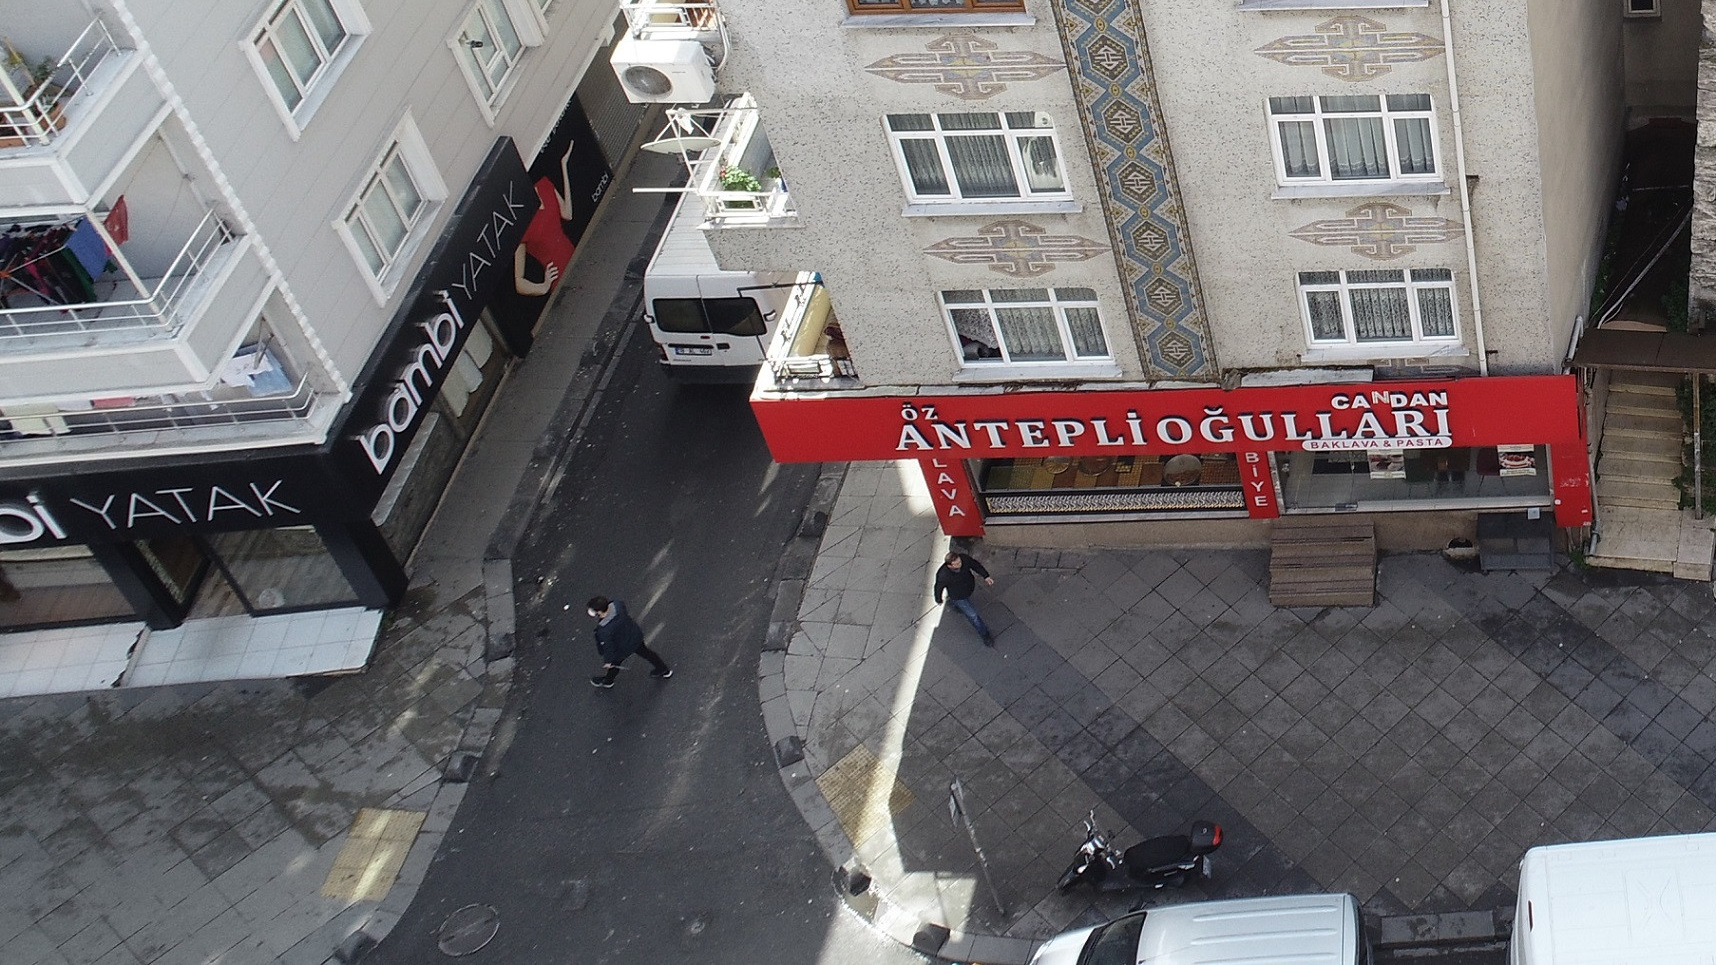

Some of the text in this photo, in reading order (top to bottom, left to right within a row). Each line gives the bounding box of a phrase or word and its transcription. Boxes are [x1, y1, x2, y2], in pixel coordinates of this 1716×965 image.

[357, 180, 525, 475] bambi YATAK
[1331, 390, 1448, 410] CANDAN
[901, 404, 938, 421] ÖZ
[1310, 437, 1444, 449] BAKLAVA & PASTA
[69, 479, 301, 530] YATAK
